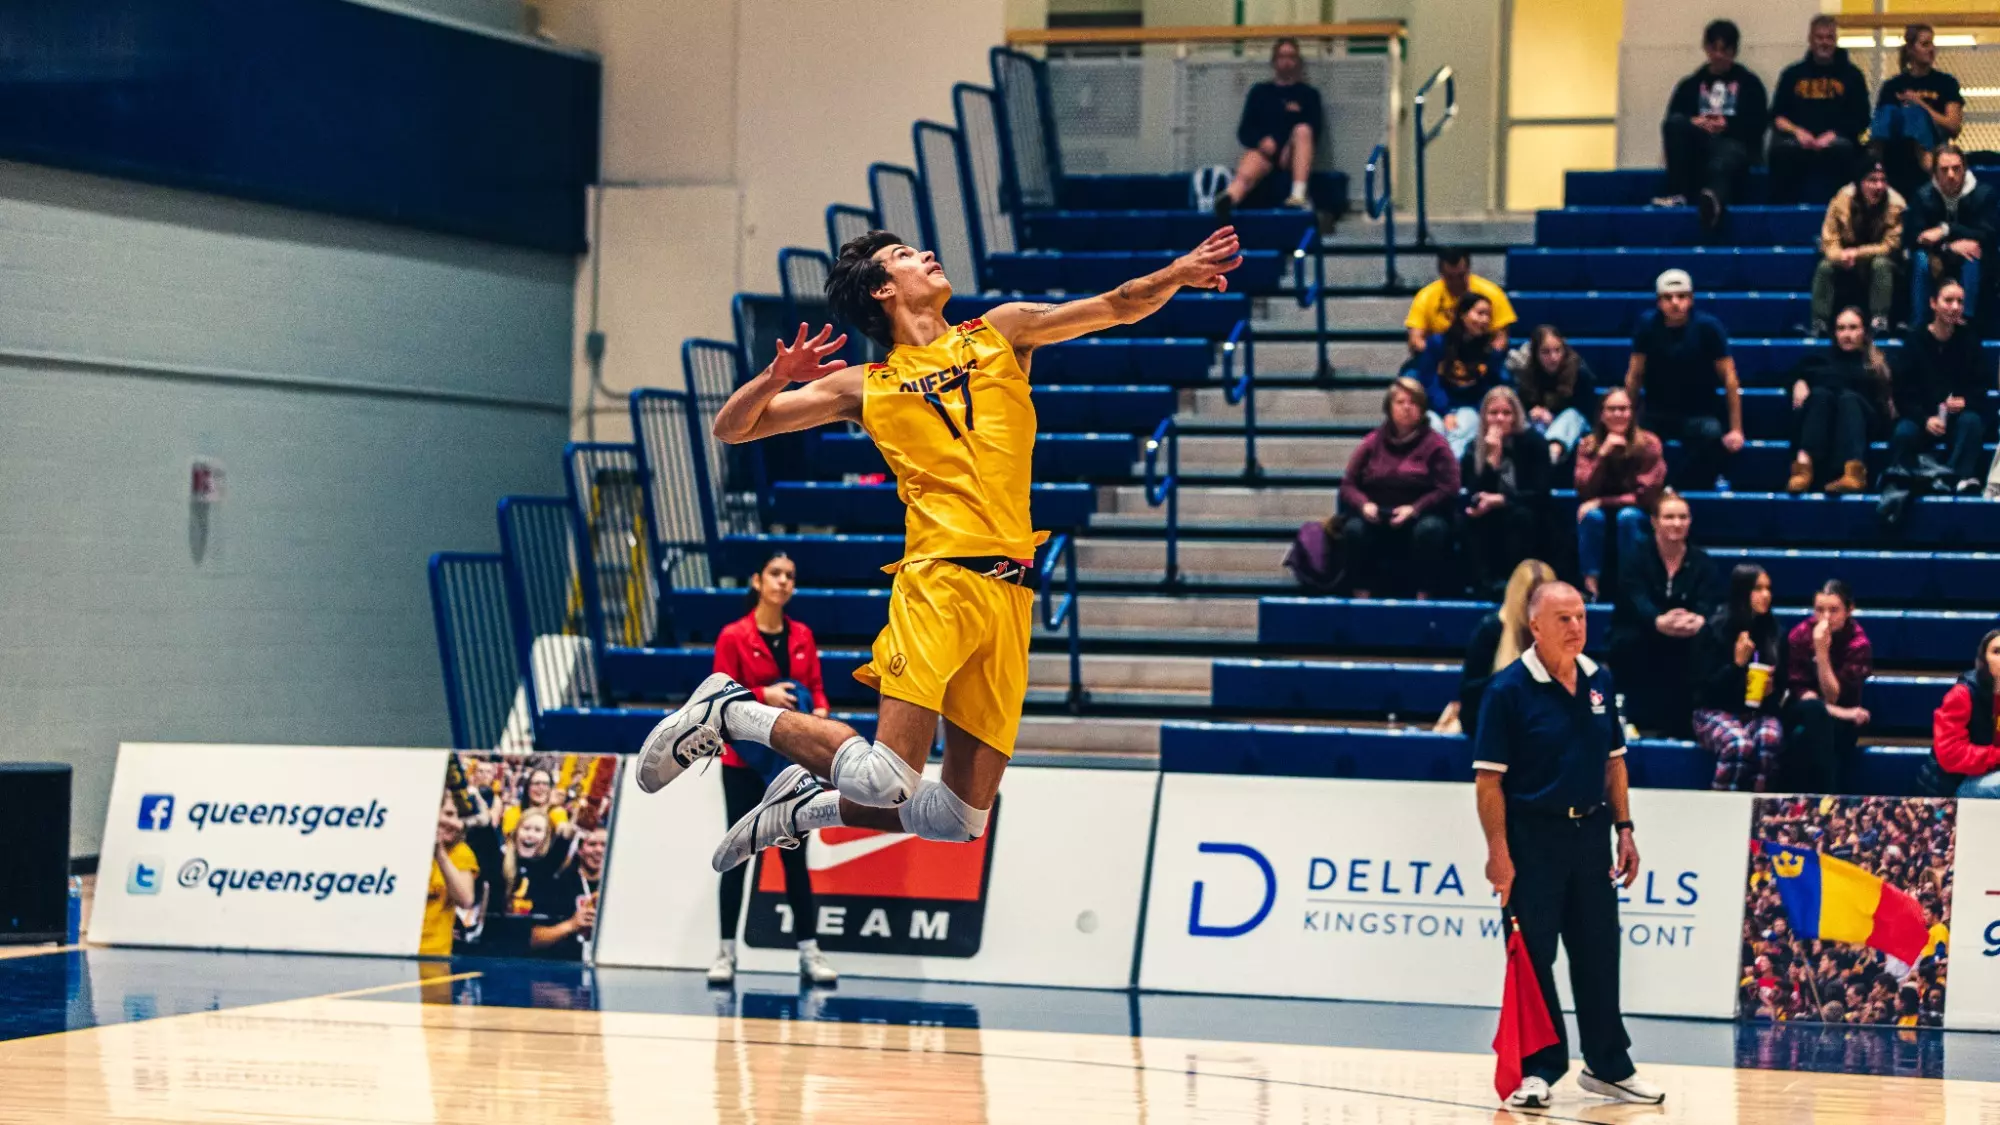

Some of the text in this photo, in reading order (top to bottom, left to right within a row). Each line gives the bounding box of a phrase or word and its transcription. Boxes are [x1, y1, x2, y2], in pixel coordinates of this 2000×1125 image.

[923, 371, 975, 441] 17
[188, 798, 389, 834] queensgaels
[177, 857, 397, 901] @queensgaels
[1307, 857, 1465, 896] DELTA
[774, 903, 951, 941] TEAM
[1303, 909, 1464, 938] KINGSTON
